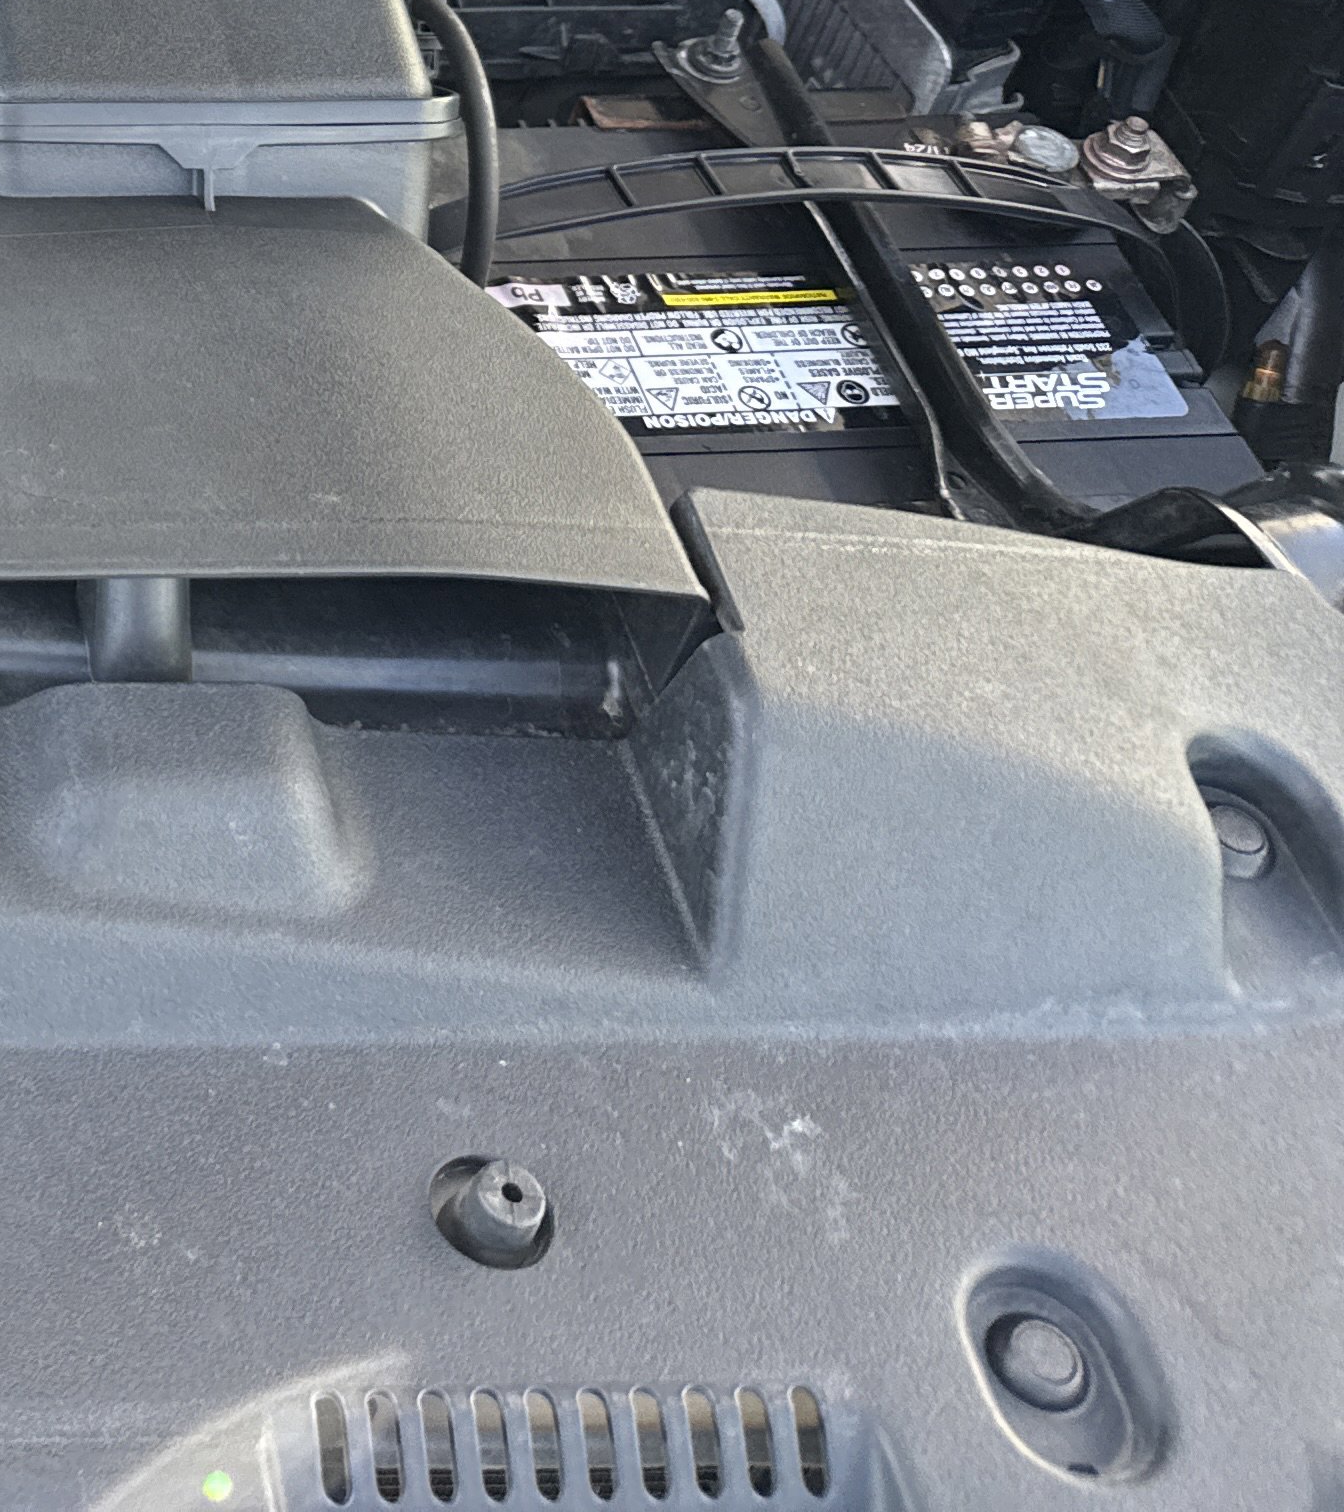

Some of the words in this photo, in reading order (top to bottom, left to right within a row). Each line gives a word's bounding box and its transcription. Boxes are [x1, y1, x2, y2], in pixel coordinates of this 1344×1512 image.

[510, 286, 545, 303] Pb
[700, 386, 723, 394] ACID
[982, 371, 1111, 395] START
[681, 395, 729, 405] SULFURIC
[988, 389, 1106, 410] SUPER
[618, 405, 648, 414] FLUSH
[643, 410, 817, 428] DANGER/POISON
